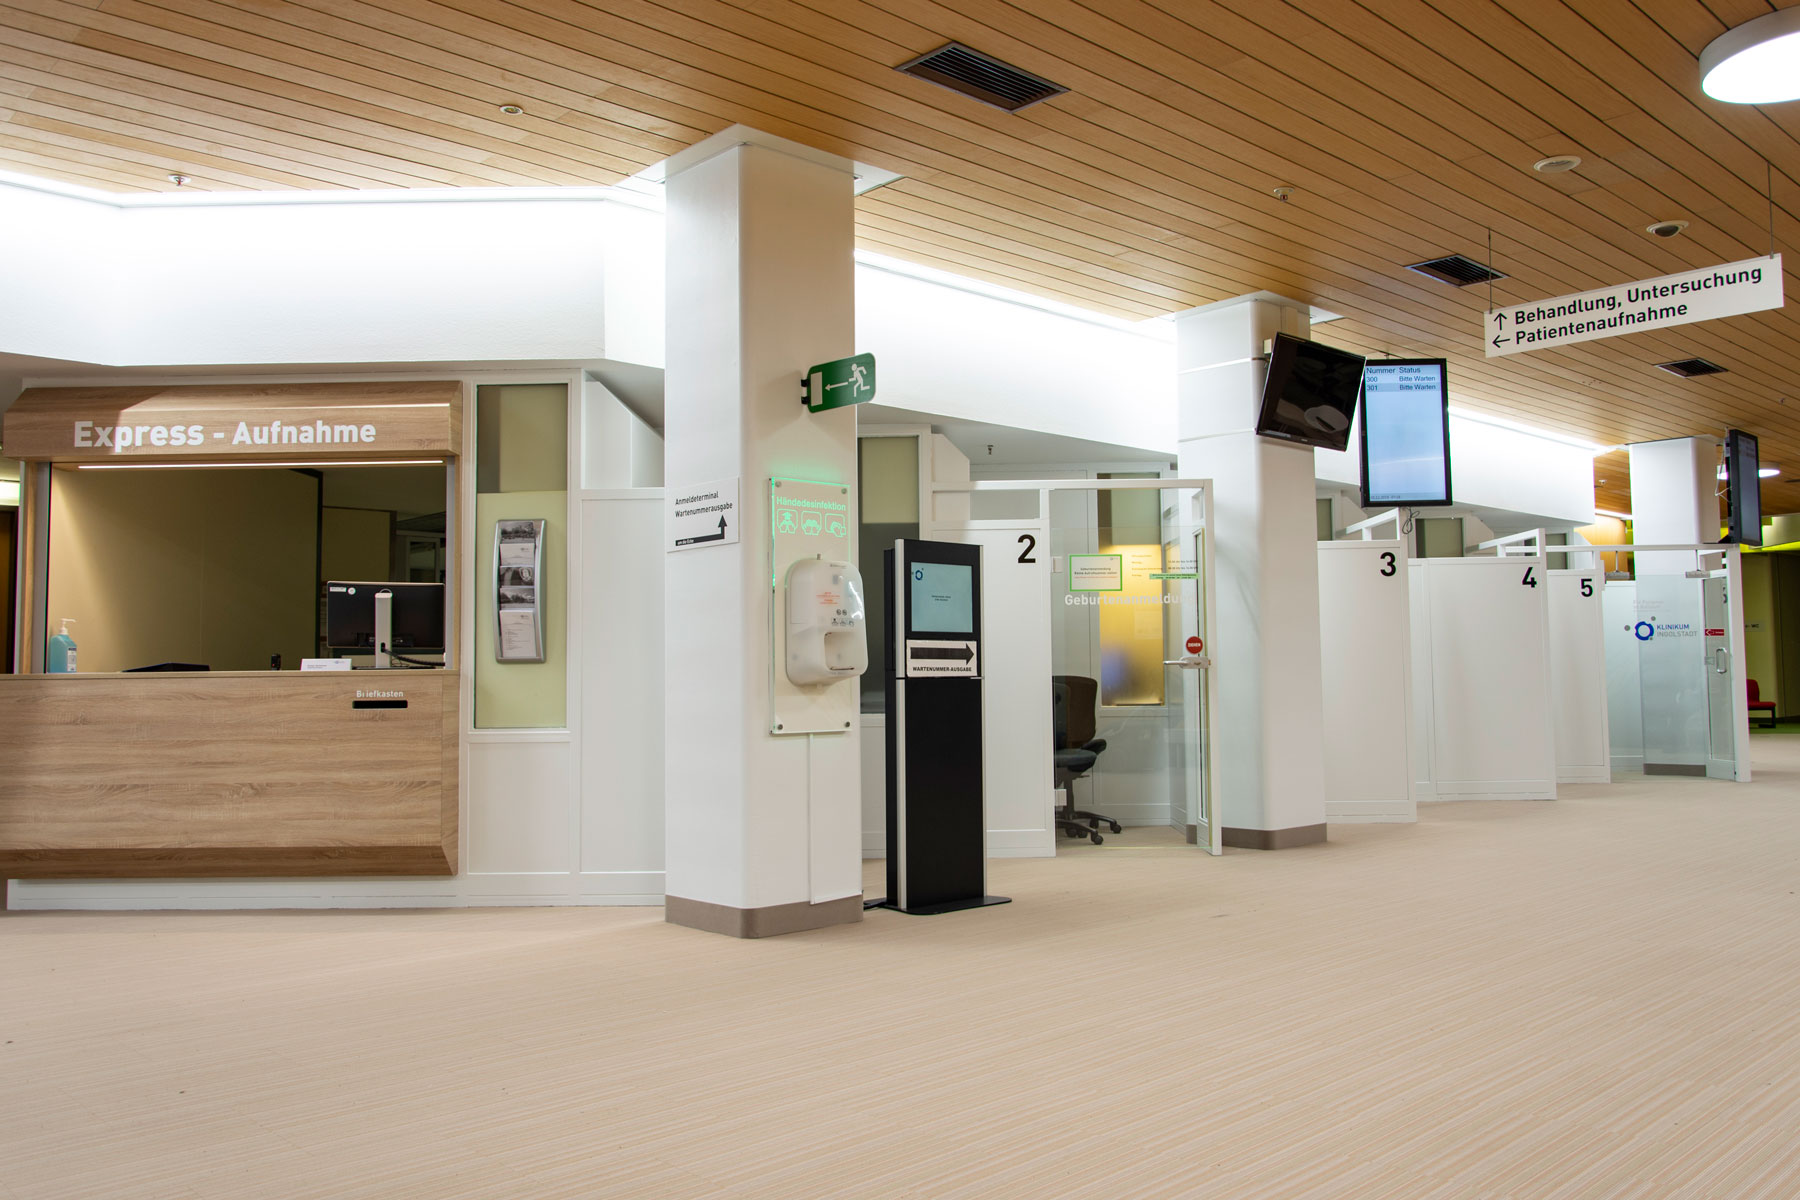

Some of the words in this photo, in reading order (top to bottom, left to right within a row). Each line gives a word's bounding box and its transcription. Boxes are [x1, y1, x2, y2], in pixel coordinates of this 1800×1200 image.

[1514, 295, 1622, 325] Behandlung,
[1626, 266, 1762, 303] Untersuchung
[1515, 303, 1688, 345] Patientenaufnahme
[1399, 366, 1421, 374] Status
[74, 421, 204, 453] Express
[231, 420, 376, 445] Aufnahme
[675, 491, 719, 505] Anmeldeterminal
[776, 496, 846, 511] Händedesinfektion
[675, 502, 733, 518] Wartenummerausgabe
[1017, 534, 1036, 564] 2
[1380, 552, 1397, 577] 3
[1522, 567, 1537, 588] 4
[1580, 578, 1594, 597] 5
[1064, 592, 1194, 606] Geburtenanmeldu
